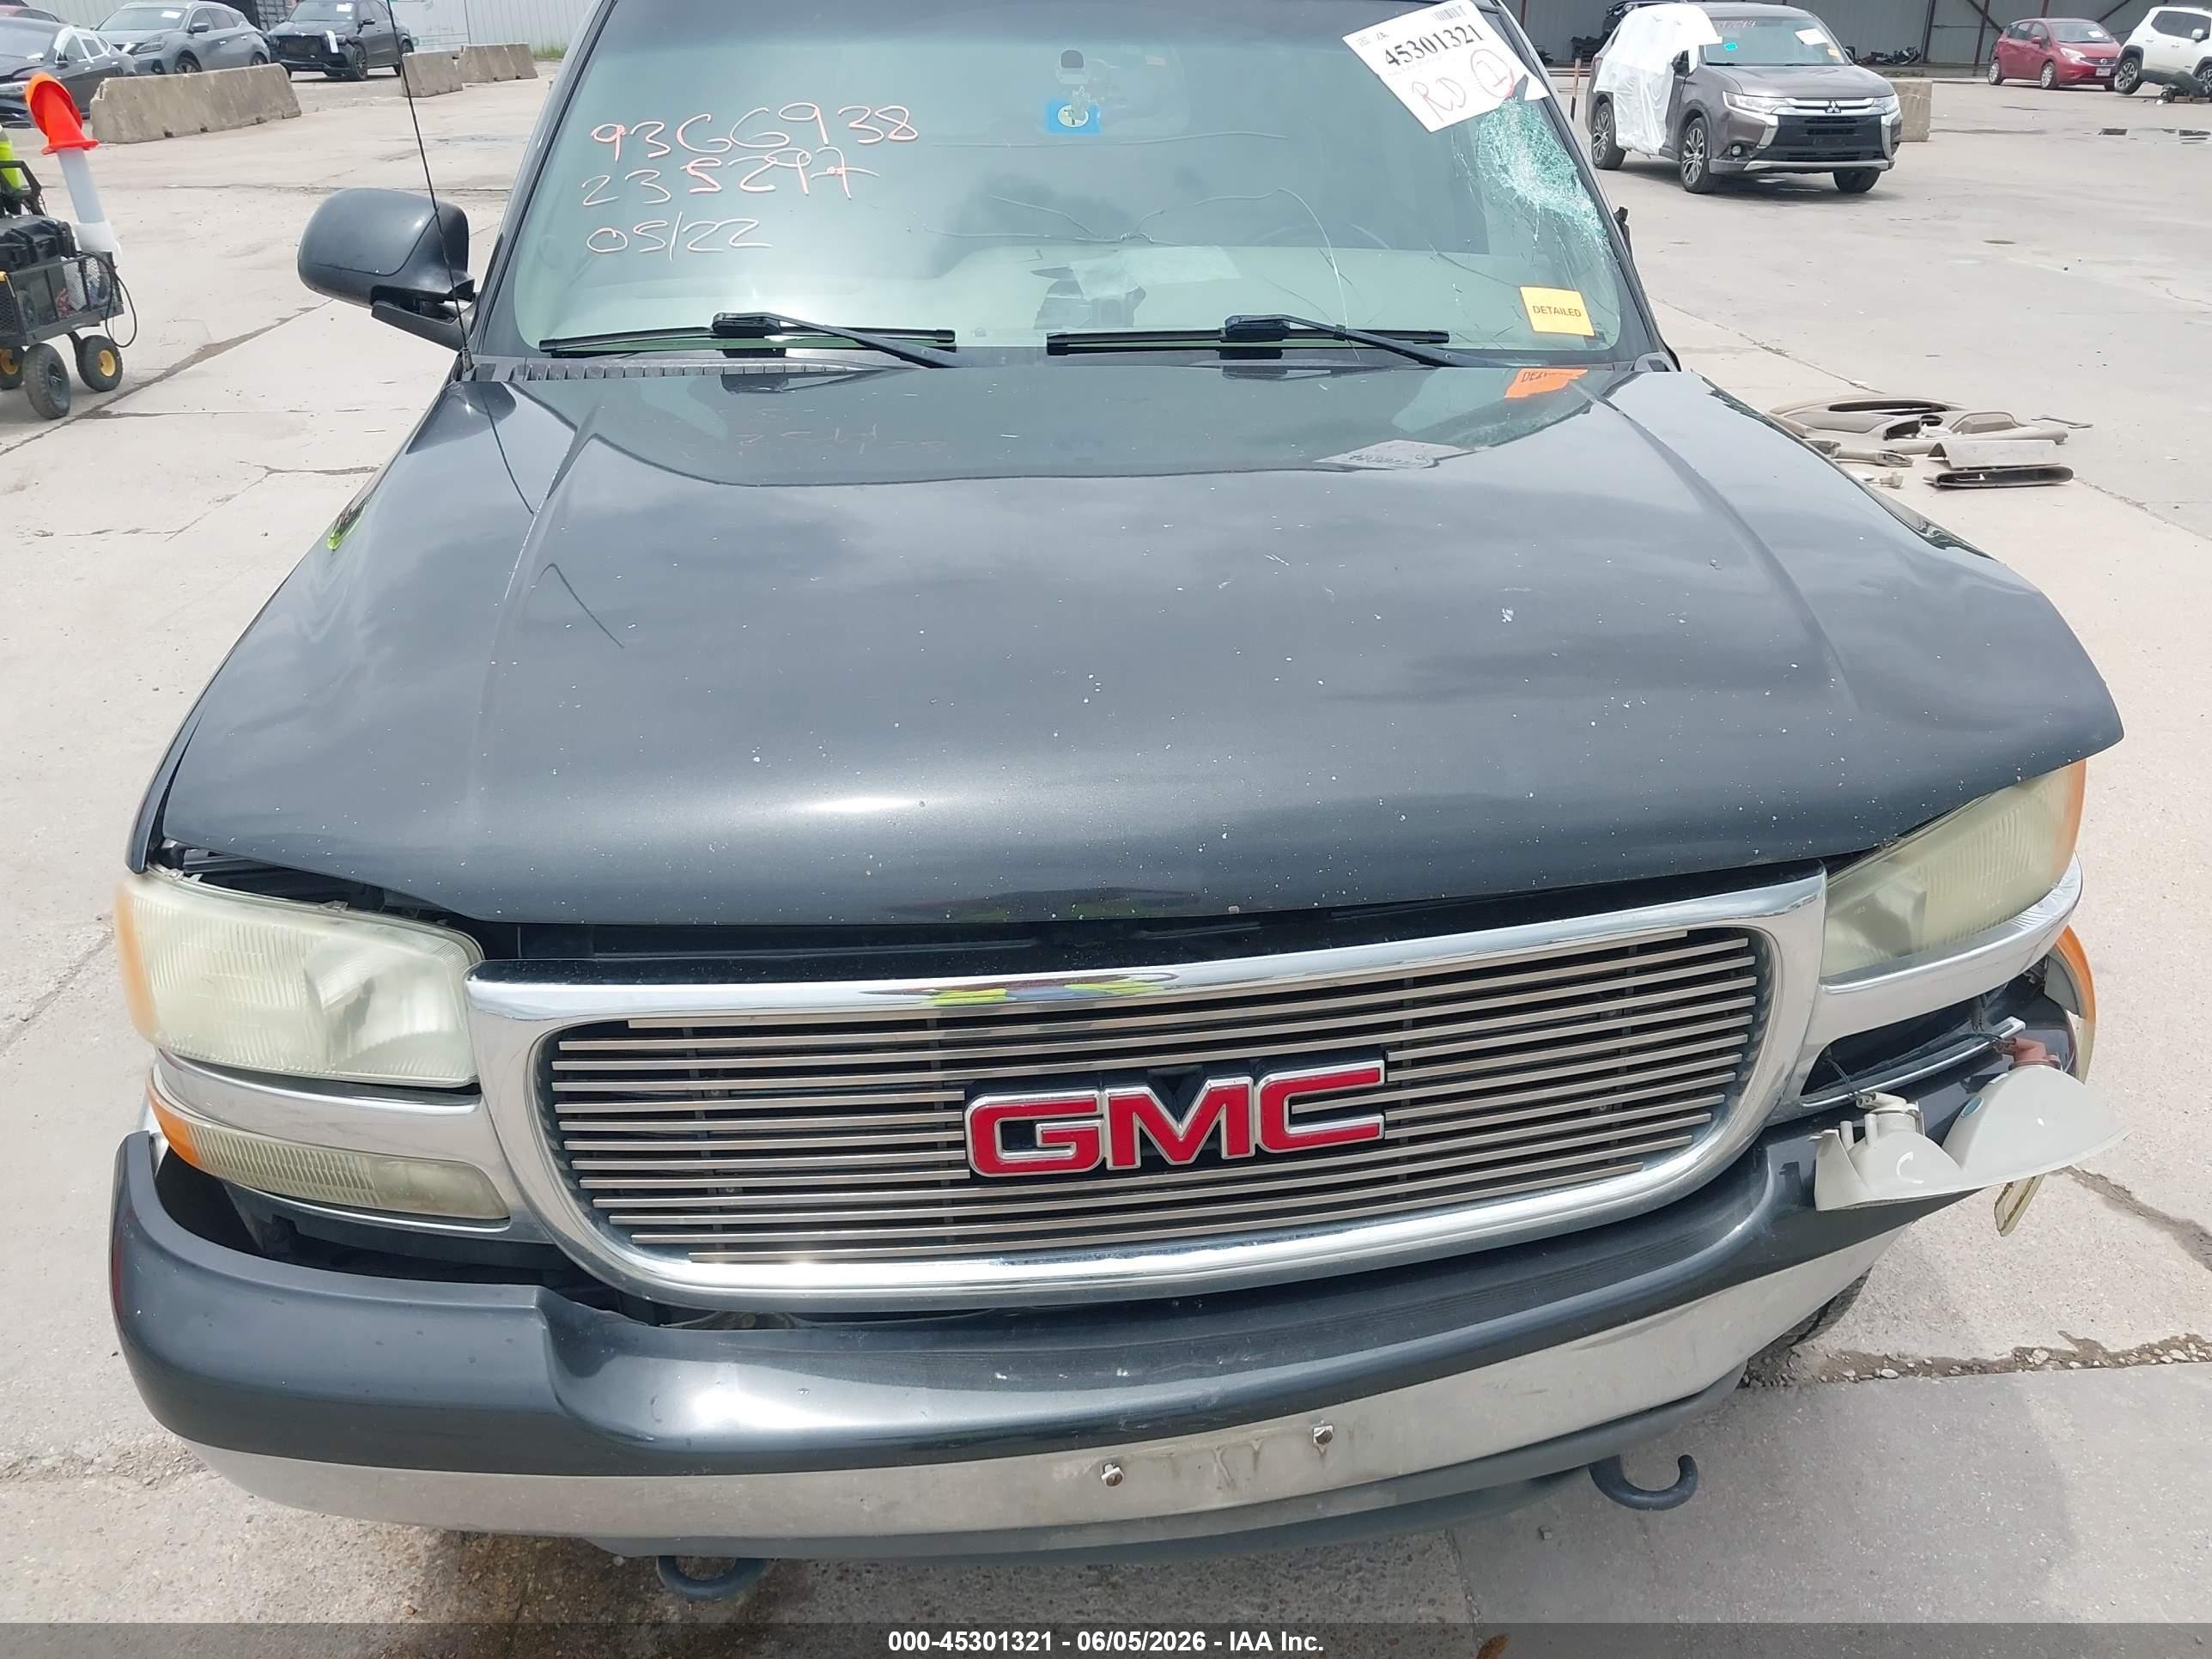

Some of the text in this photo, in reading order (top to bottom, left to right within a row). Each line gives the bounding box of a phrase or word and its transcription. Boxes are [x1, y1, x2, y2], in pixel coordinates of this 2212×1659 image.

[1385, 24, 1484, 66] 45301321
[586, 211, 774, 262] 05/22
[1532, 305, 1582, 318] DETAILED
[967, 1060, 1385, 1177] GMC
